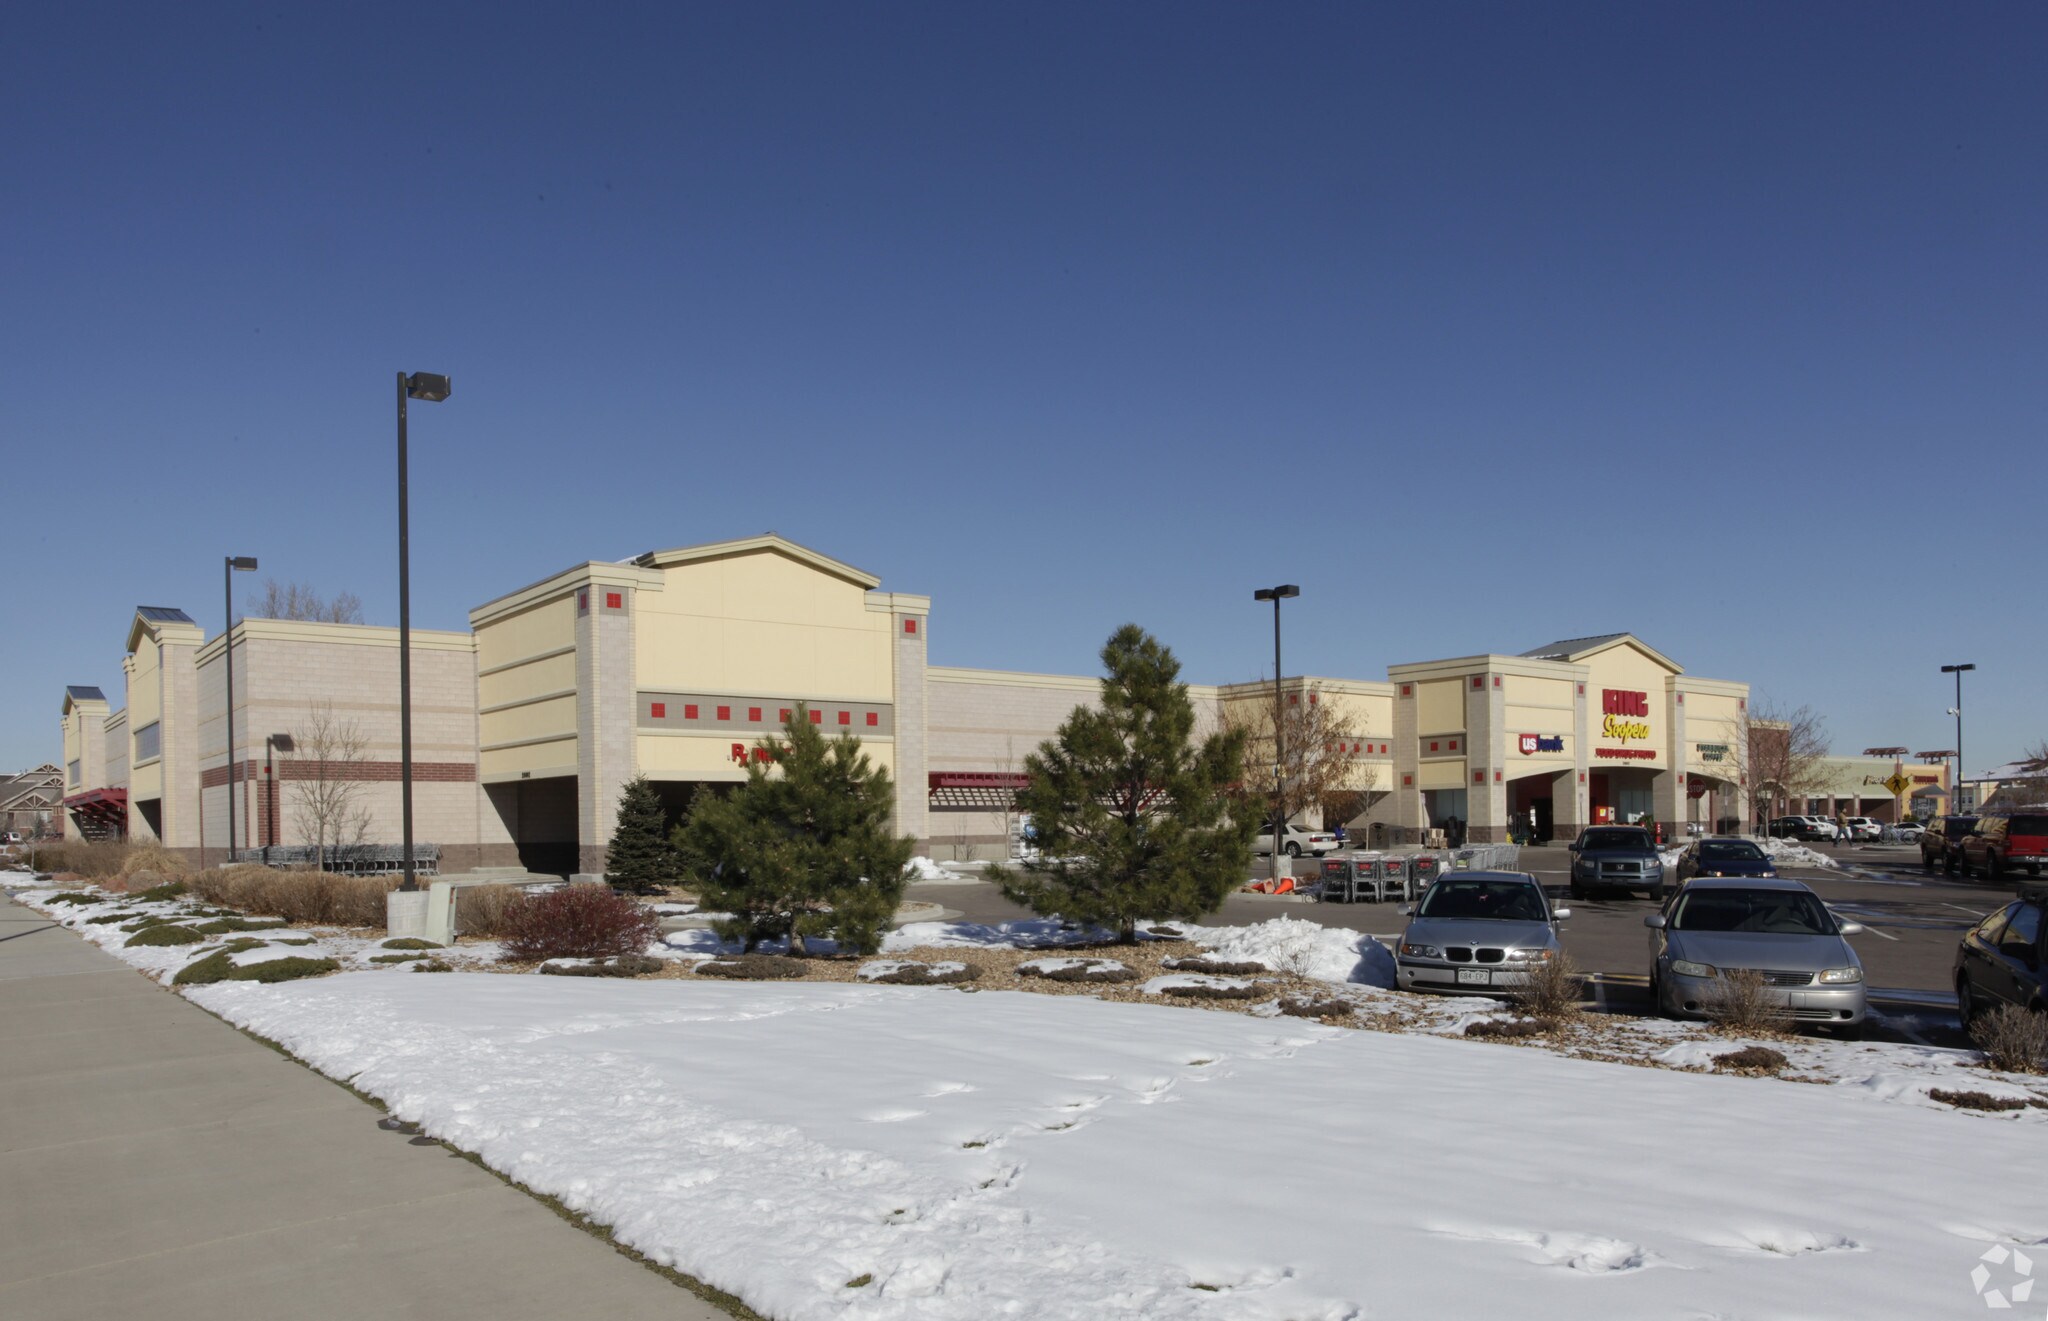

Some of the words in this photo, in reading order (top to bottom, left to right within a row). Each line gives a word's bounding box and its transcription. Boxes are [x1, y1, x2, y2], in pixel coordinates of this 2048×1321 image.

[1602, 689, 1648, 717] KING
[1602, 714, 1649, 744] Soopers
[1688, 784, 1704, 793] STOP
